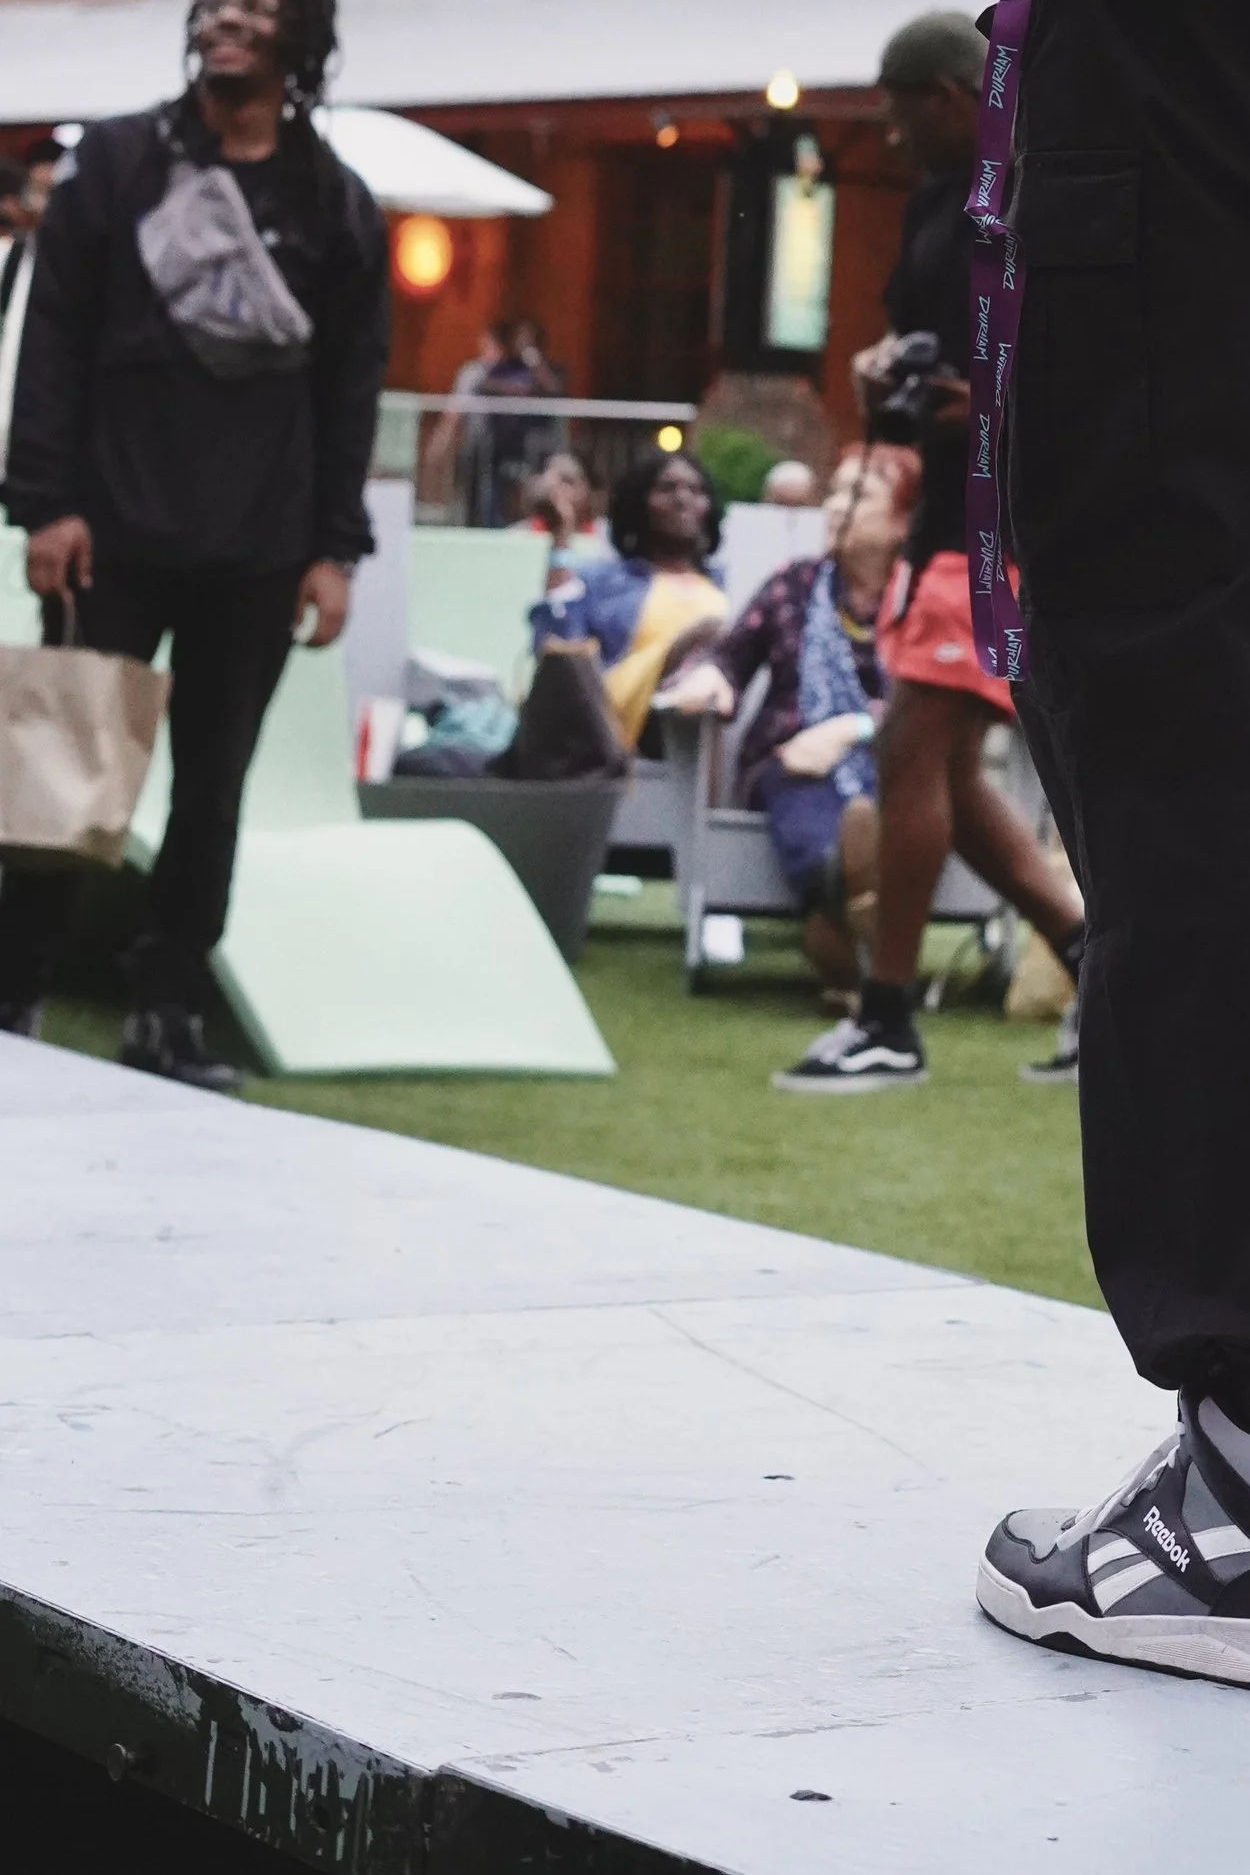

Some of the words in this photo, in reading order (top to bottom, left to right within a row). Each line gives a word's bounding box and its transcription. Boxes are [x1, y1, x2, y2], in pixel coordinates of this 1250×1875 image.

[988, 44, 1019, 109] DURHAM
[976, 159, 1003, 207] URHAM
[973, 295, 991, 361] DURHAM
[995, 342, 1012, 408] DURHAM
[972, 413, 992, 478] DURHAM
[1142, 1505, 1191, 1573] Reebok
